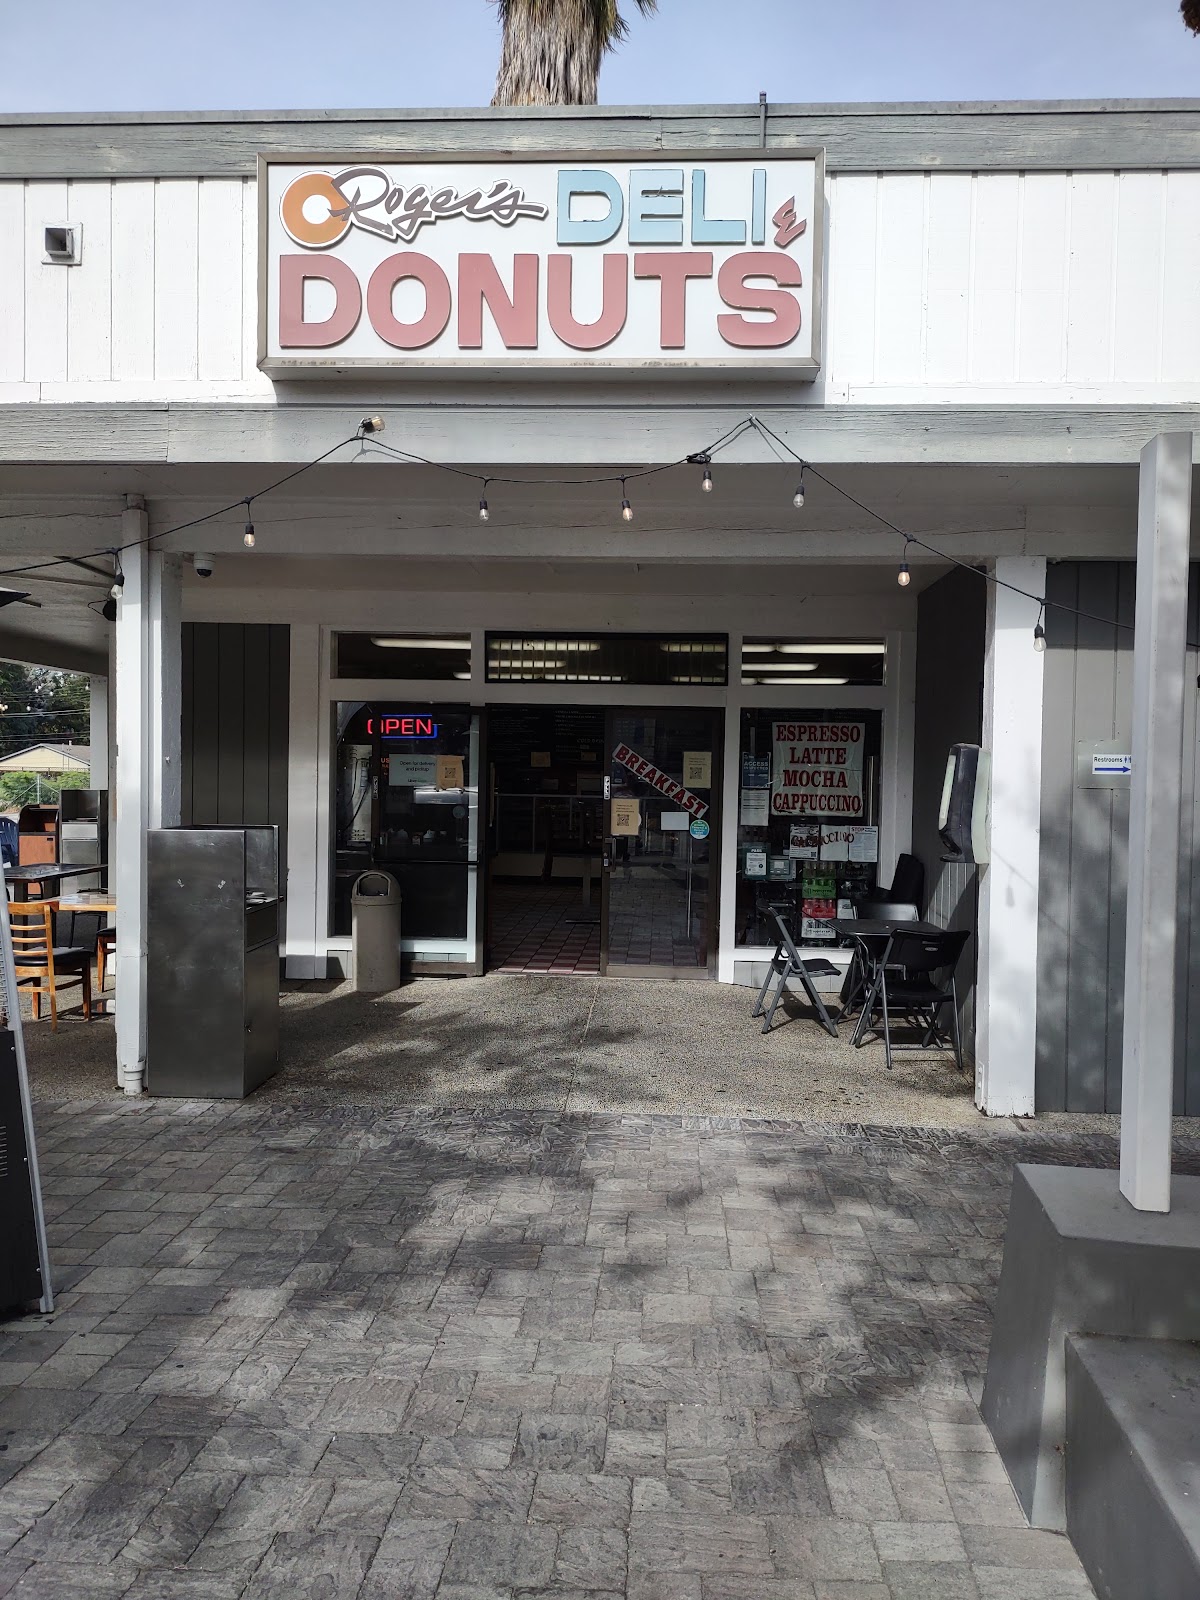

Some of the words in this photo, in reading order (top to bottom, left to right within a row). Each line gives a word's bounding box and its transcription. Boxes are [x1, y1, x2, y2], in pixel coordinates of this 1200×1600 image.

[329, 167, 547, 238] Roger's
[557, 168, 766, 244] DELI
[278, 251, 802, 349] DONUTS
[367, 719, 432, 735] OPEN
[776, 724, 861, 743] ESPRESSO
[789, 747, 847, 765] LATTE
[615, 744, 708, 817] BREAKFAST
[783, 769, 848, 788] MOCHA
[773, 792, 862, 814] CAPPUCCINO
